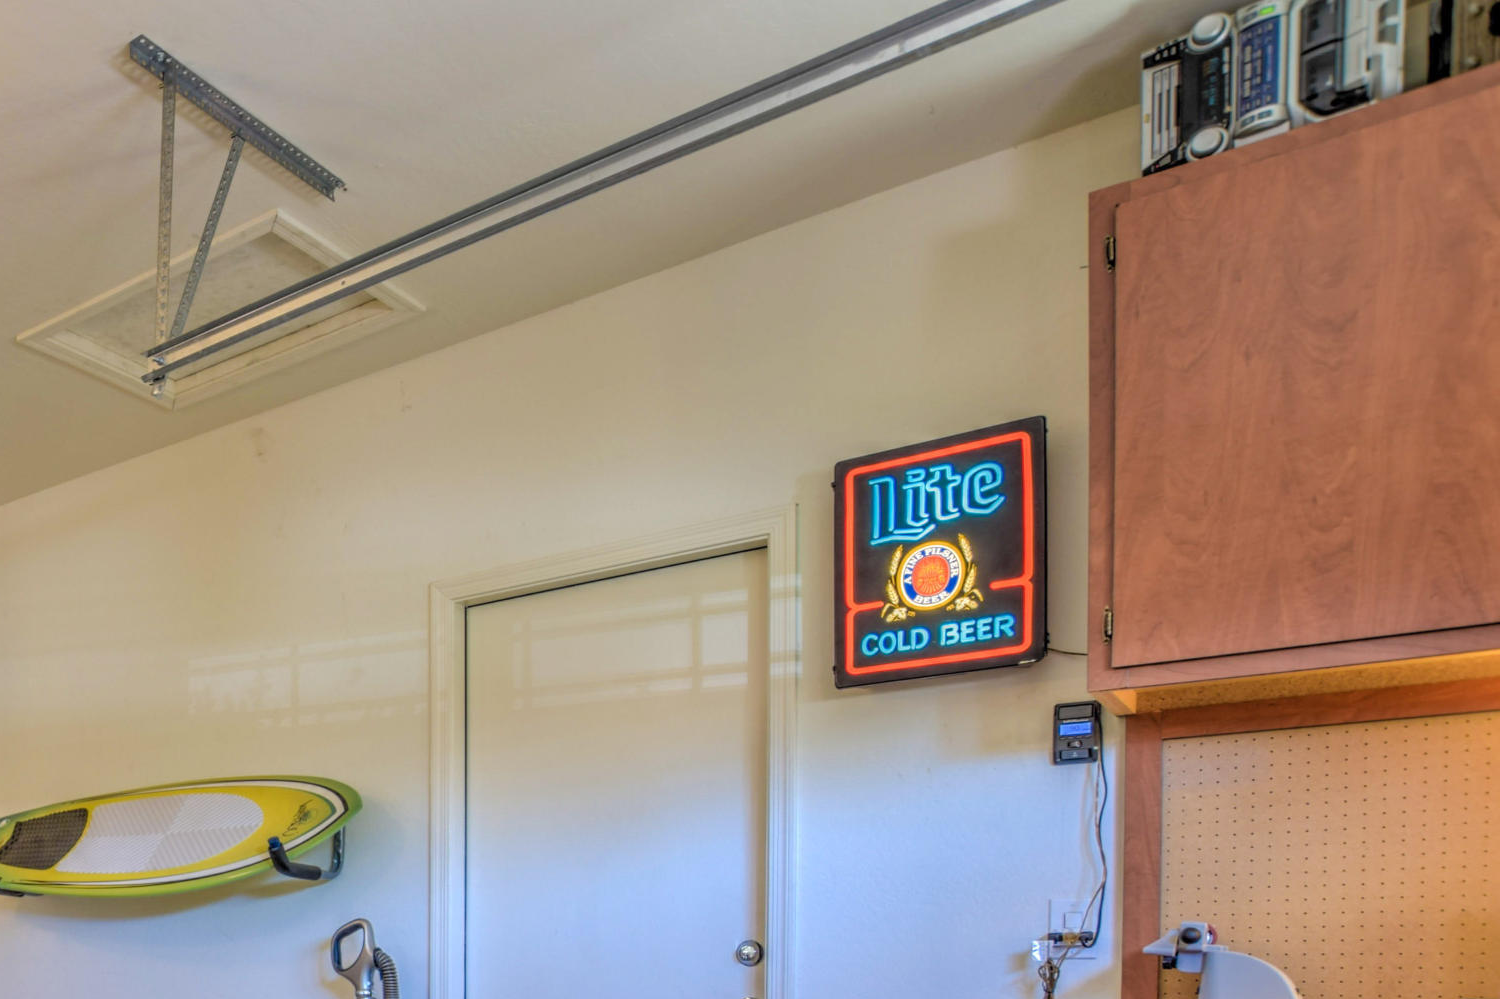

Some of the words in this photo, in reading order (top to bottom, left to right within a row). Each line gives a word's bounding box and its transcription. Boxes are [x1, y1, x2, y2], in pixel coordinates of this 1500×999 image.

[868, 461, 1007, 546] Lite
[925, 547, 959, 578] PILSNER
[914, 591, 951, 604] BEER
[861, 626, 930, 657] COLD
[940, 614, 1016, 646] BEER
